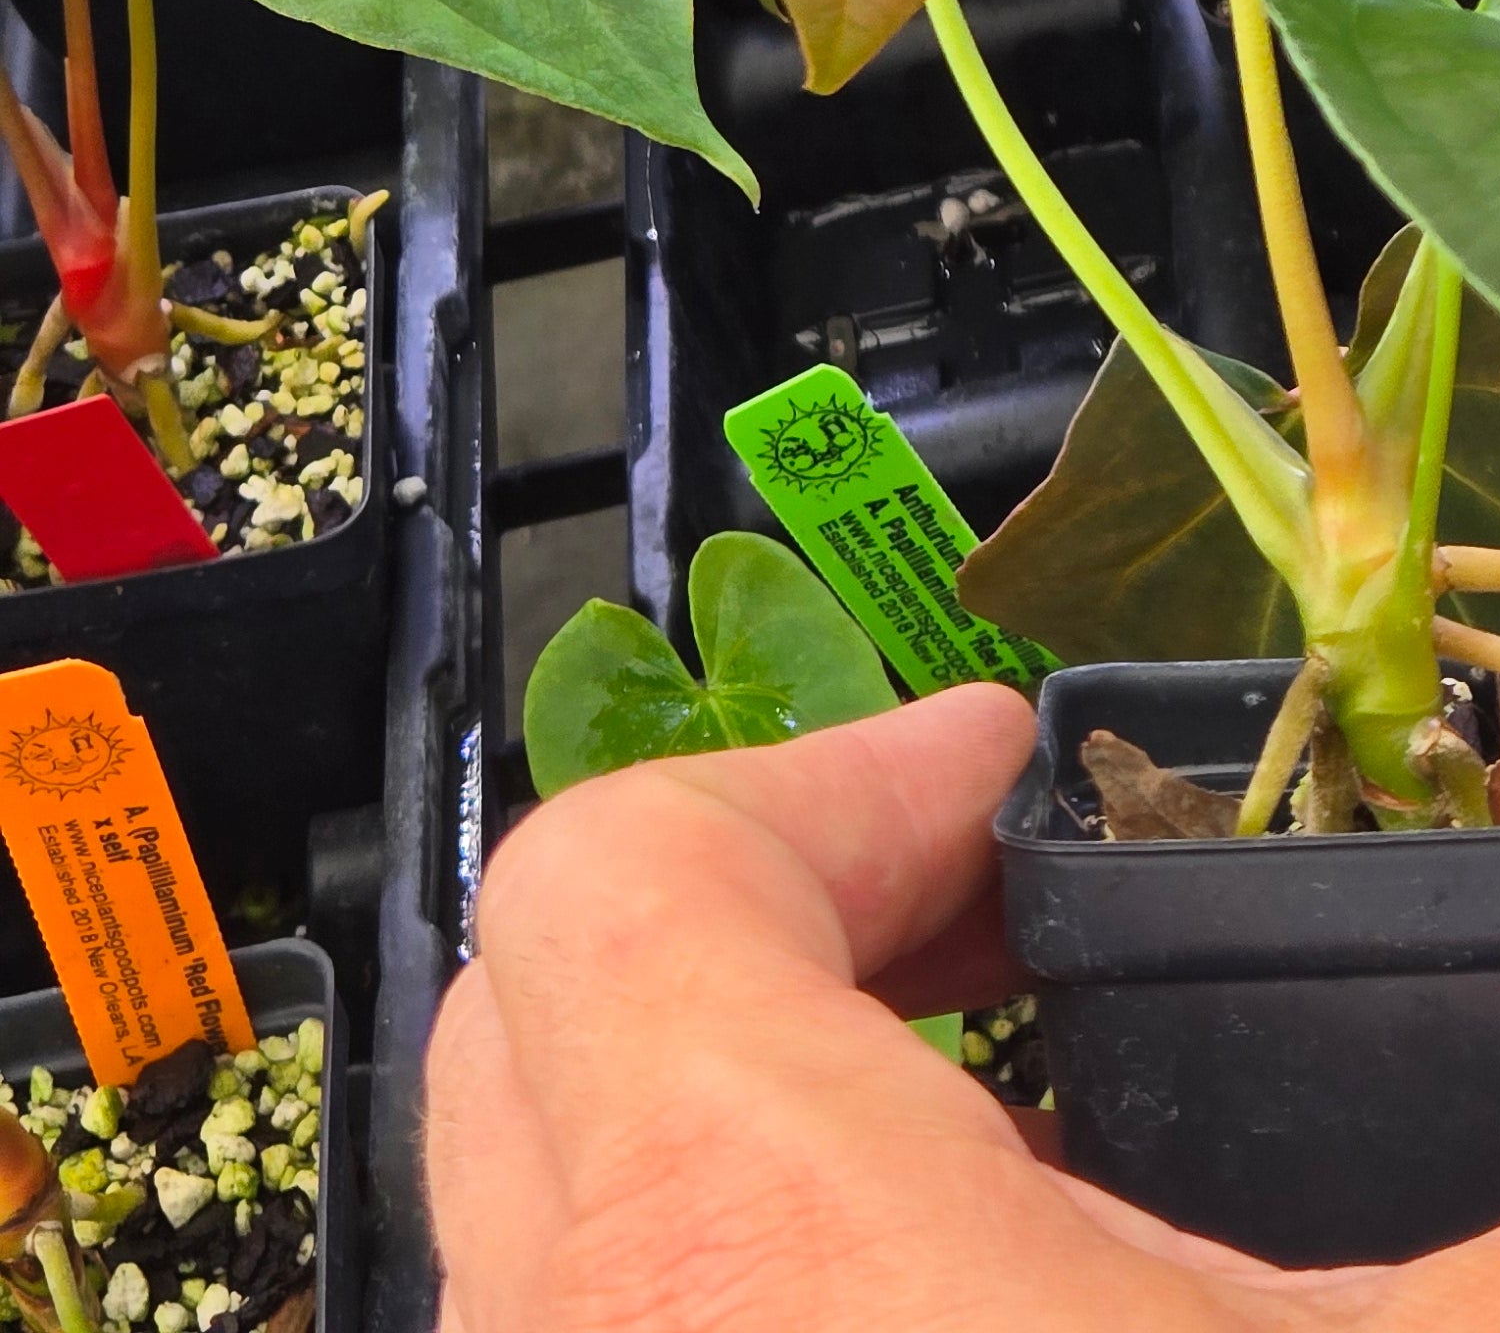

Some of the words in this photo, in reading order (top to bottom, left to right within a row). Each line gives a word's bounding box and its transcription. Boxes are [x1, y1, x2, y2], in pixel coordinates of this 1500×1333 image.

[863, 499, 890, 519] A.
[893, 483, 965, 572] Anthurium
[818, 521, 887, 600] Established
[879, 598, 914, 633] 2018
[907, 631, 936, 664] New
[92, 816, 113, 829] x
[122, 803, 149, 824] A.
[98, 831, 132, 865] self
[64, 818, 162, 1048] www.niceplantsgoodpots.com
[70, 907, 98, 944] 2018
[85, 945, 109, 978] New
[98, 981, 131, 1043] Orleans,
[121, 1044, 143, 1067] LA
